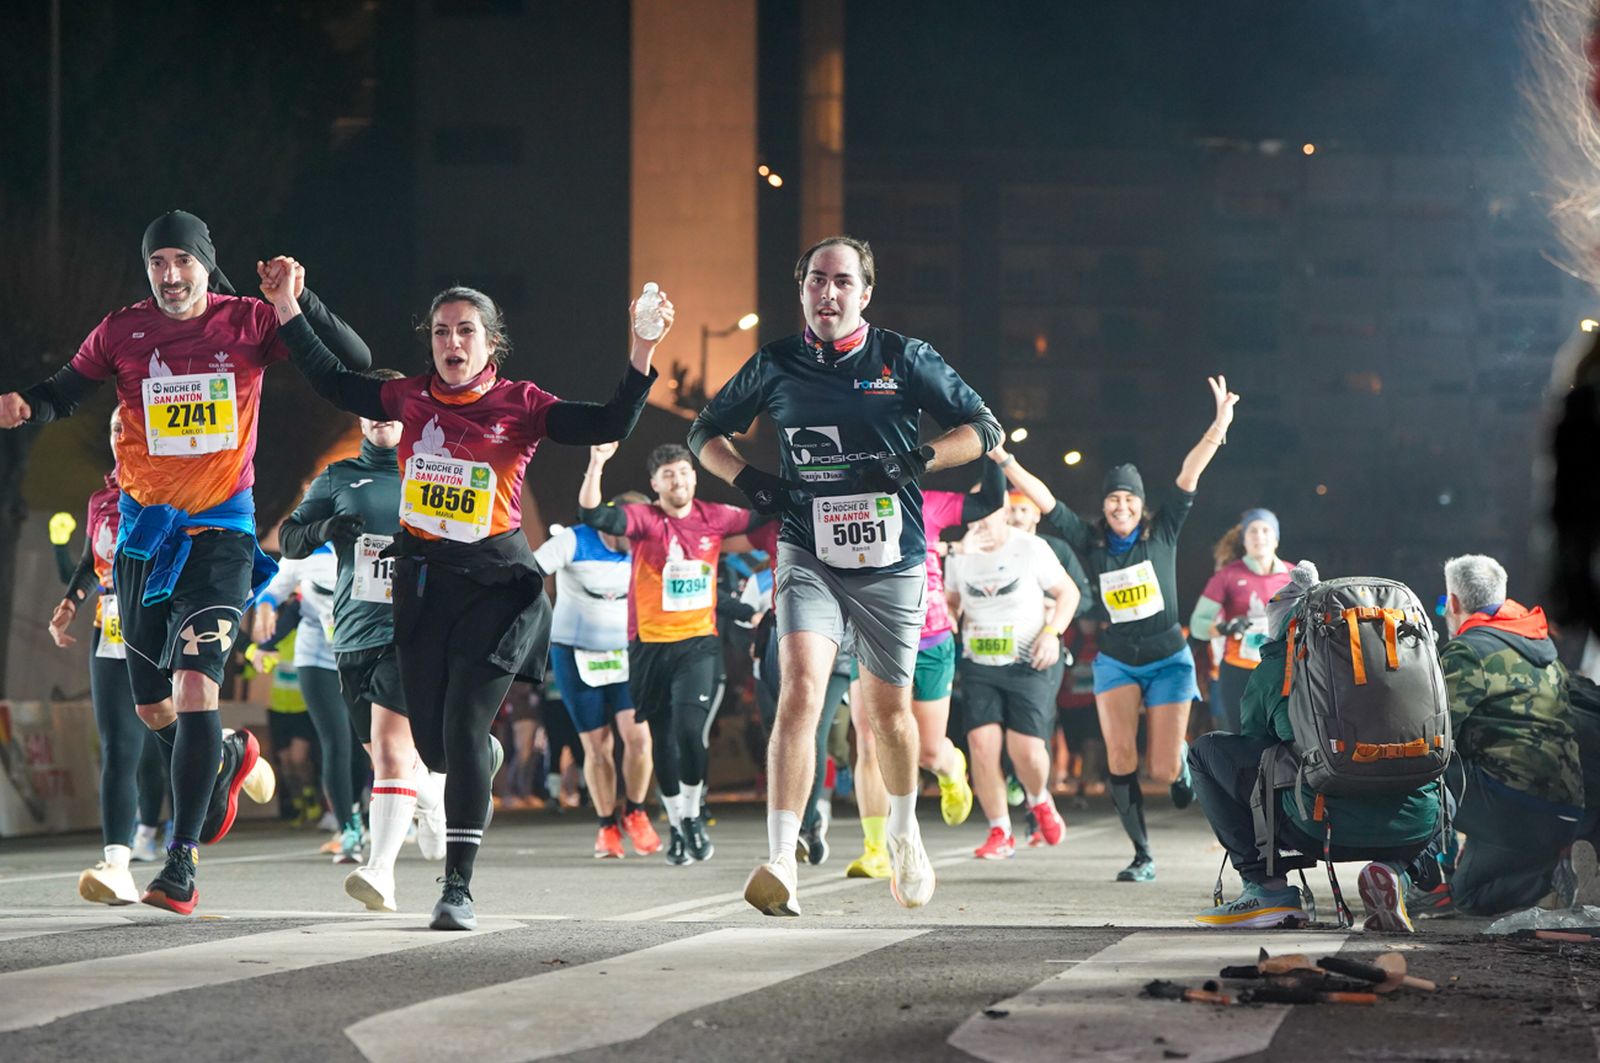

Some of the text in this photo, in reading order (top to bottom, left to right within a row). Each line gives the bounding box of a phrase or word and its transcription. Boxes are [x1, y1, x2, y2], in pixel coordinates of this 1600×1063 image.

[163, 384, 189, 394] NOCHE
[191, 383, 202, 392] DE
[853, 378, 898, 390] IronBells
[154, 396, 172, 404] SAN
[174, 393, 203, 404] ANTÓN
[166, 402, 217, 428] 2741
[425, 463, 452, 474] NOCHE
[453, 466, 464, 476] DE
[415, 472, 432, 481] SAN
[432, 474, 463, 486] ANTÓN
[420, 483, 476, 514] 1856
[832, 503, 857, 512] NOCHE
[859, 502, 869, 510] DE
[823, 515, 841, 524] SAN
[842, 511, 870, 522] ANTÓN
[832, 520, 887, 547] 5051
[671, 577, 707, 594] 12394
[1112, 584, 1147, 605] 12777
[976, 638, 1007, 652] 3667
[1228, 898, 1260, 912] HOKA
